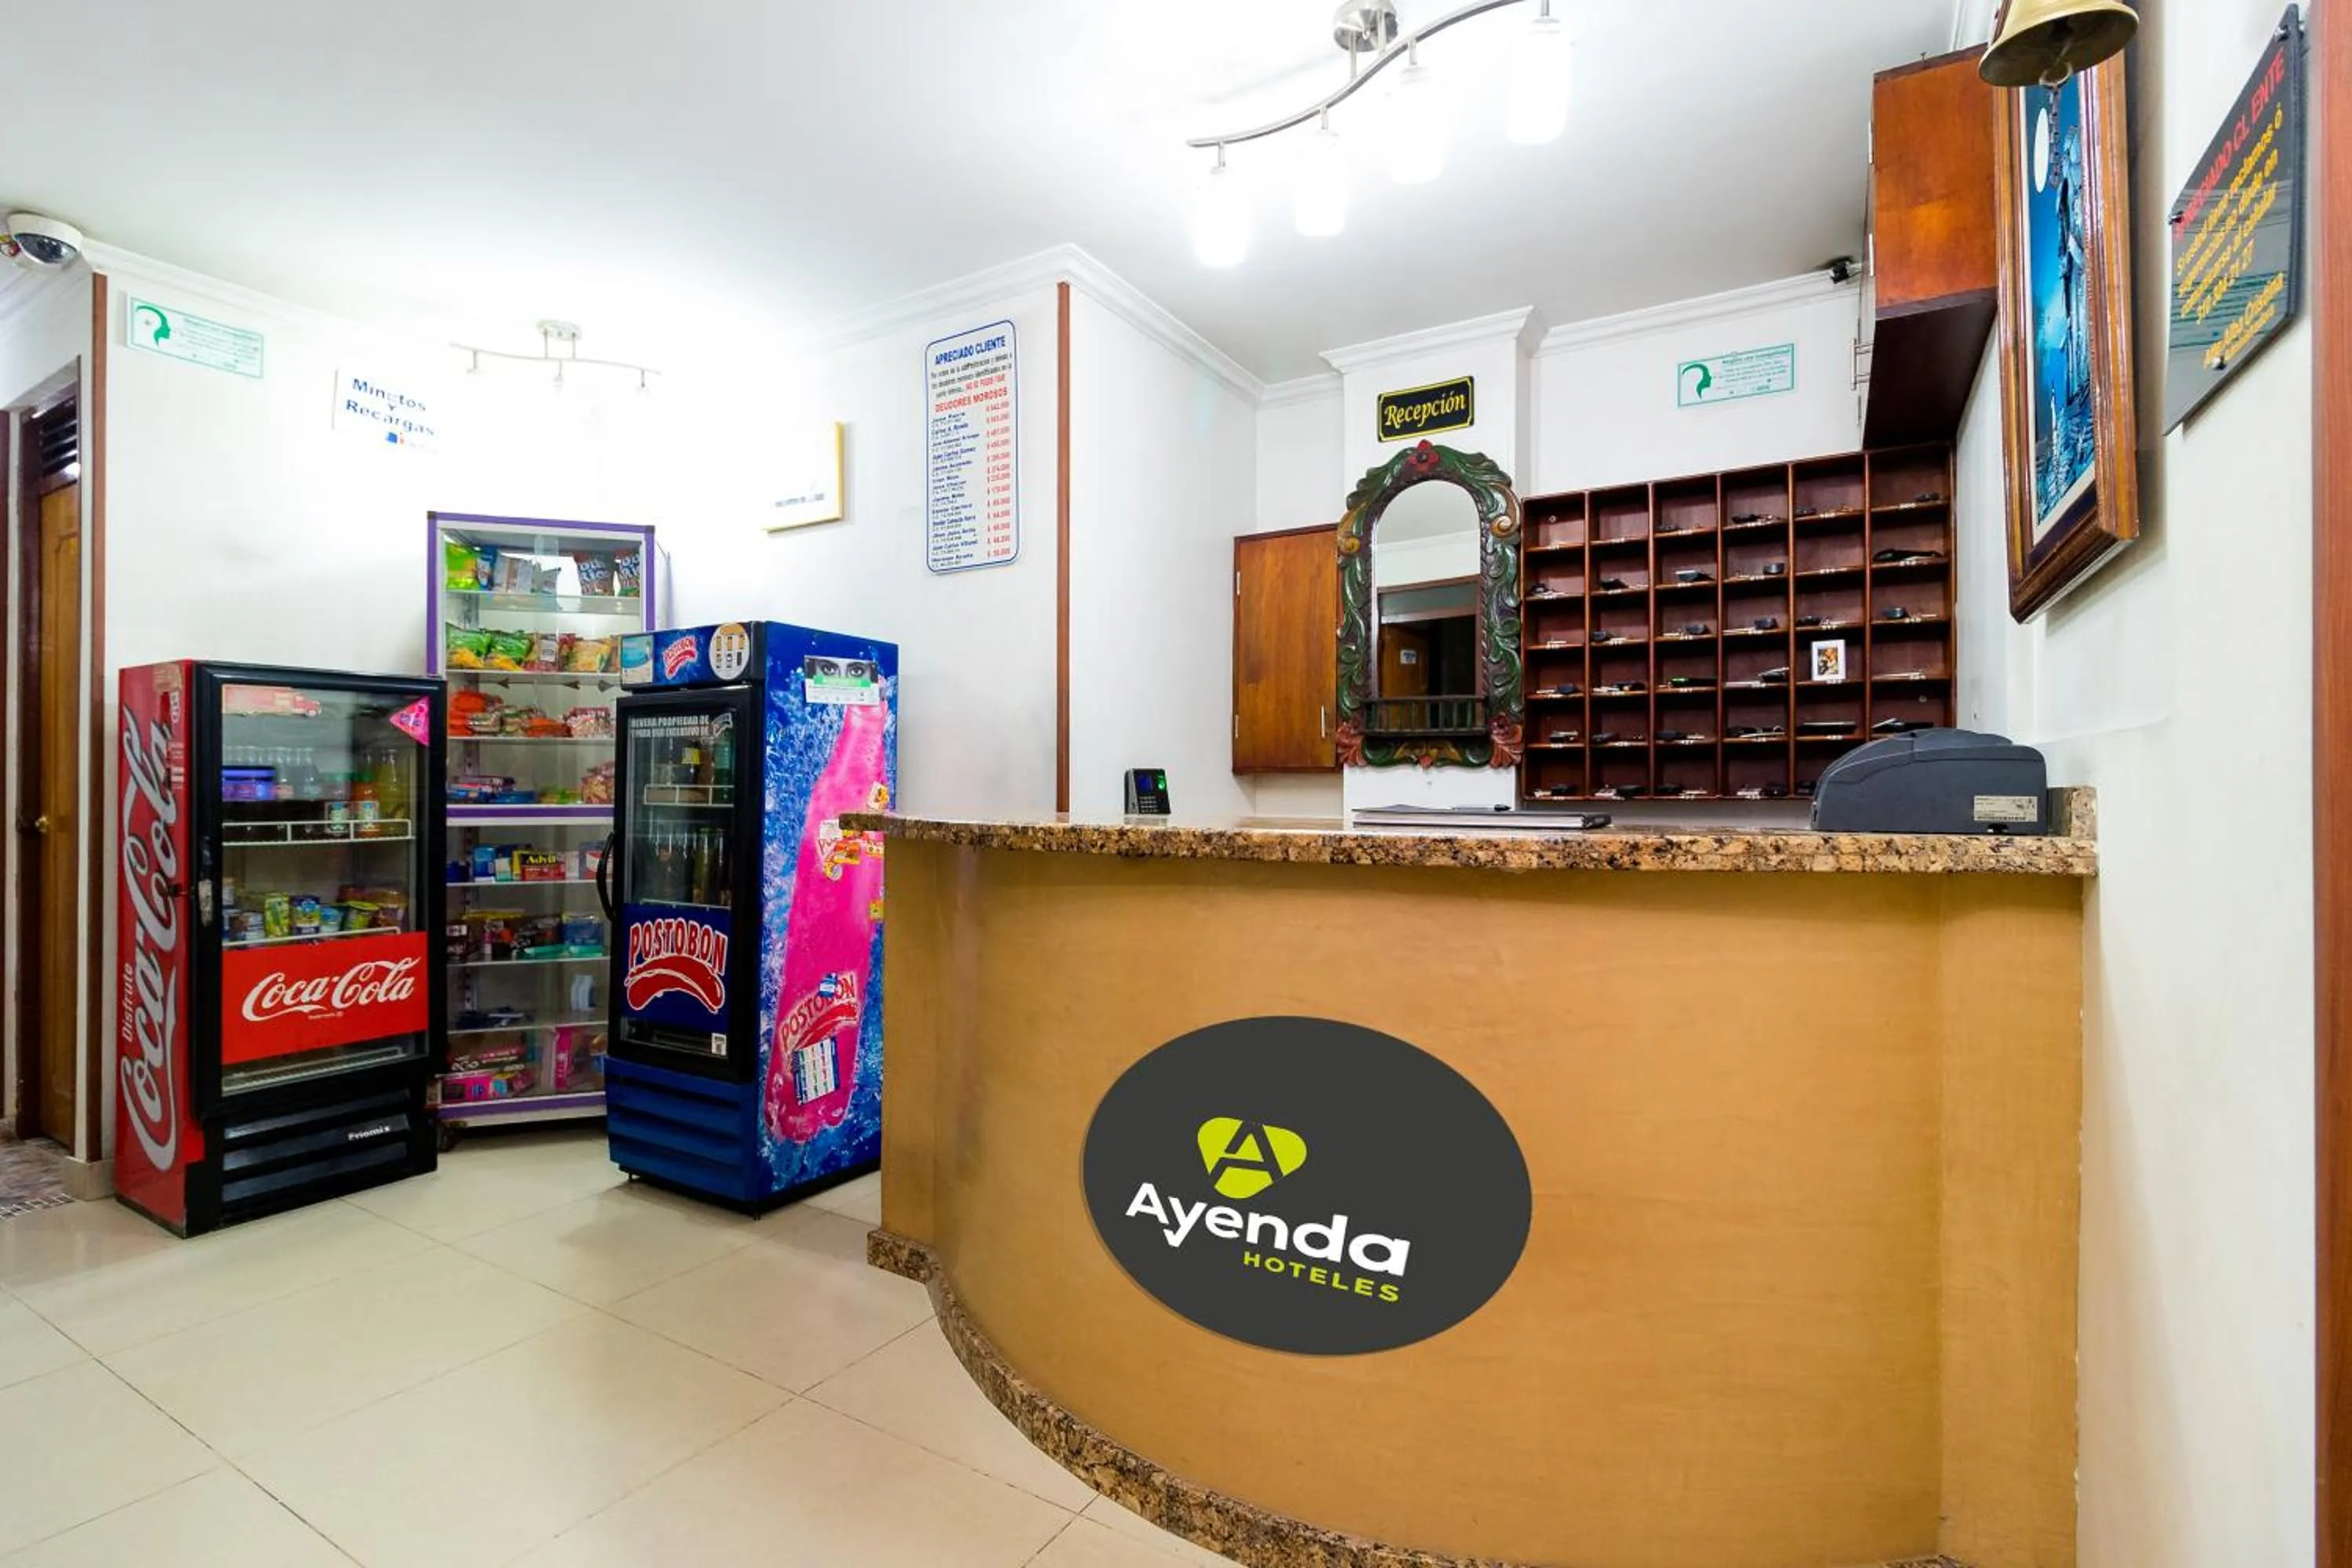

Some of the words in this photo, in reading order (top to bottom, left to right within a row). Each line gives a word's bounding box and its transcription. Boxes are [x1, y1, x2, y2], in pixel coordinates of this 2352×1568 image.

[2230, 123, 2274, 198] reclamos
[2263, 148, 2278, 178] en
[935, 345, 973, 365] APRECIADO
[975, 336, 1006, 354] CLIENTE
[346, 399, 434, 437] Recargas
[352, 378, 426, 412] Mintos
[935, 395, 971, 412] DEUDORES
[973, 387, 1007, 402] MOROSOS
[1384, 390, 1466, 429] Recepción
[121, 702, 178, 1171] Coca-Cola
[630, 917, 728, 976] POSTOBON
[122, 962, 133, 1043] Disfrute
[242, 956, 422, 1022] Coca-Cola
[1125, 1182, 1410, 1277] Ayenda
[1243, 1251, 1400, 1303] HOTELES
